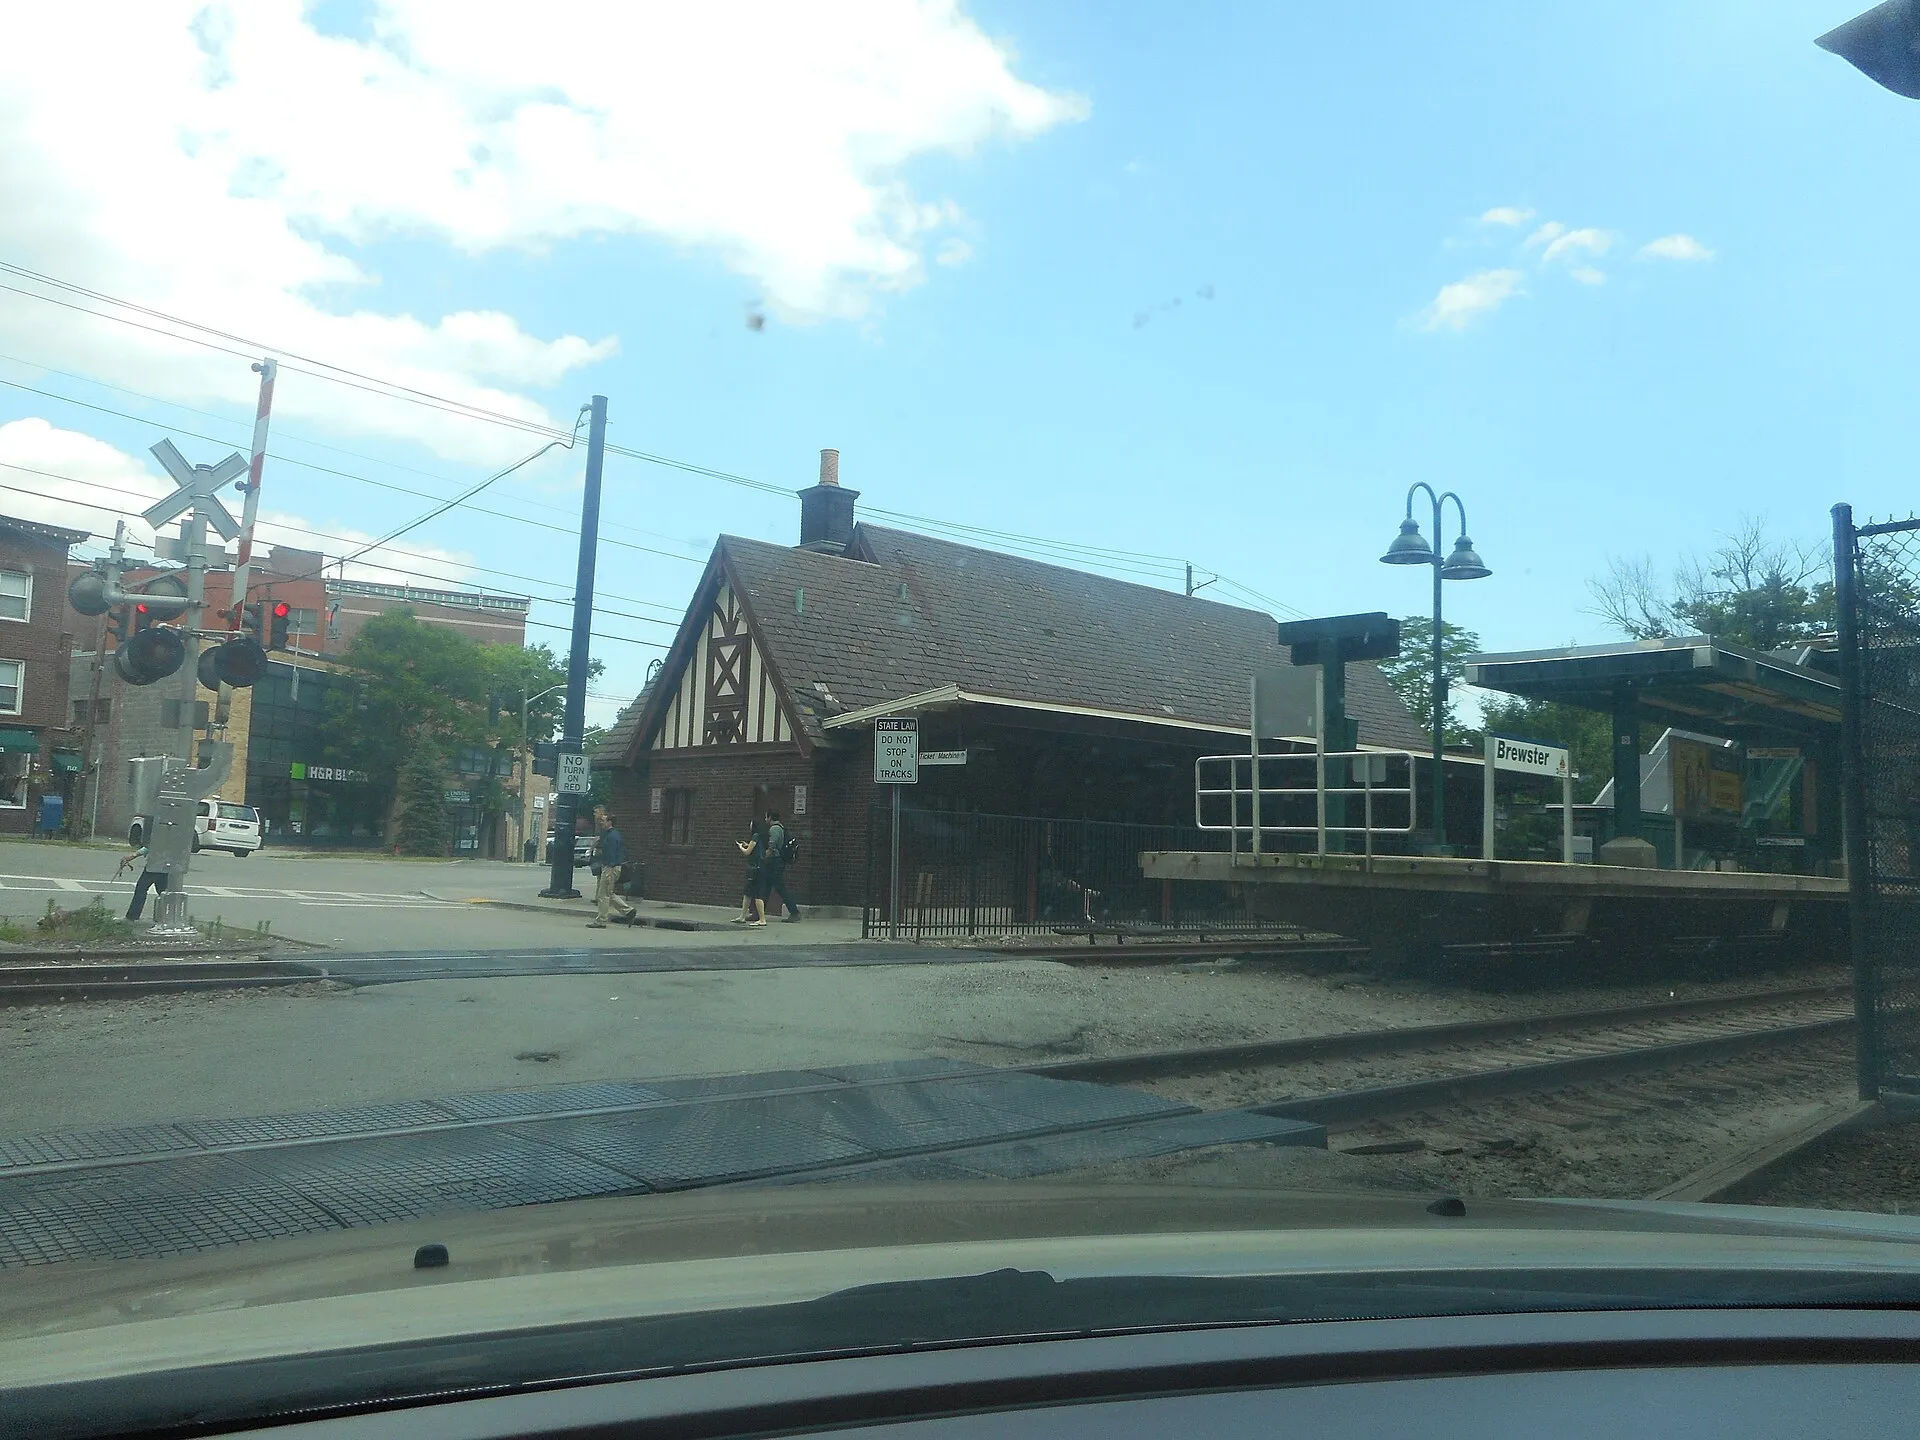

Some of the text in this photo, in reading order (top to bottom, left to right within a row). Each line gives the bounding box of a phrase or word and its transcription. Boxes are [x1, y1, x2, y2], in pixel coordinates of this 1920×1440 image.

[878, 721, 915, 730] STATE LAW
[881, 735, 912, 744] DO NOT
[886, 748, 906, 756] STOP
[1497, 740, 1549, 765] Brewster
[565, 756, 583, 765] NO
[310, 766, 332, 780] H&R
[564, 766, 584, 774] TURN
[880, 770, 912, 778] TRACKS
[564, 783, 580, 791] RED
